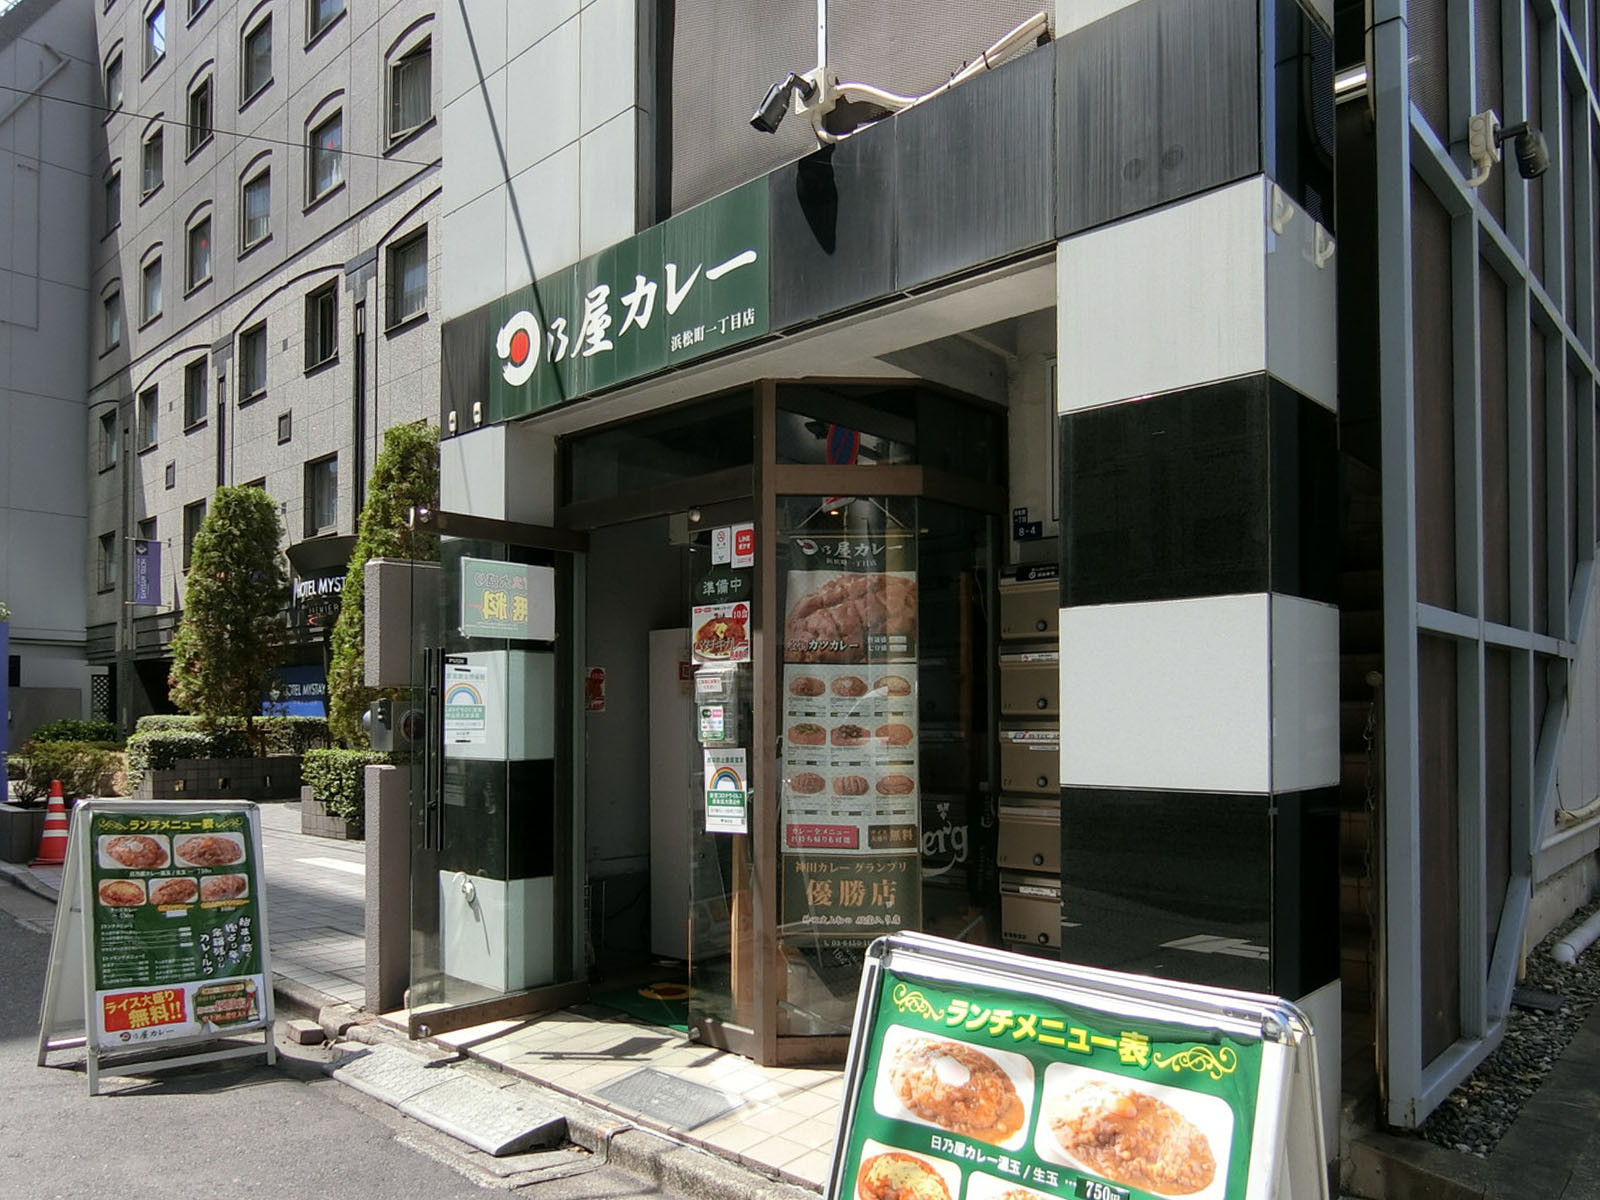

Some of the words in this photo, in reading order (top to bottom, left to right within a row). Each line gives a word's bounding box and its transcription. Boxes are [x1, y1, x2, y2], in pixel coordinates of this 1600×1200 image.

[670, 308, 755, 351] 浜松町一丁目店
[738, 535, 751, 543] LINE
[296, 579, 316, 598] HOTEL
[702, 577, 742, 596] 準備中
[129, 818, 215, 830] ランチメニュー表
[806, 879, 897, 907] 優勝店
[105, 990, 175, 1015] ライス大盛り
[129, 1001, 182, 1029] 無料!!
[945, 999, 1151, 1065] ランチメニュー表
